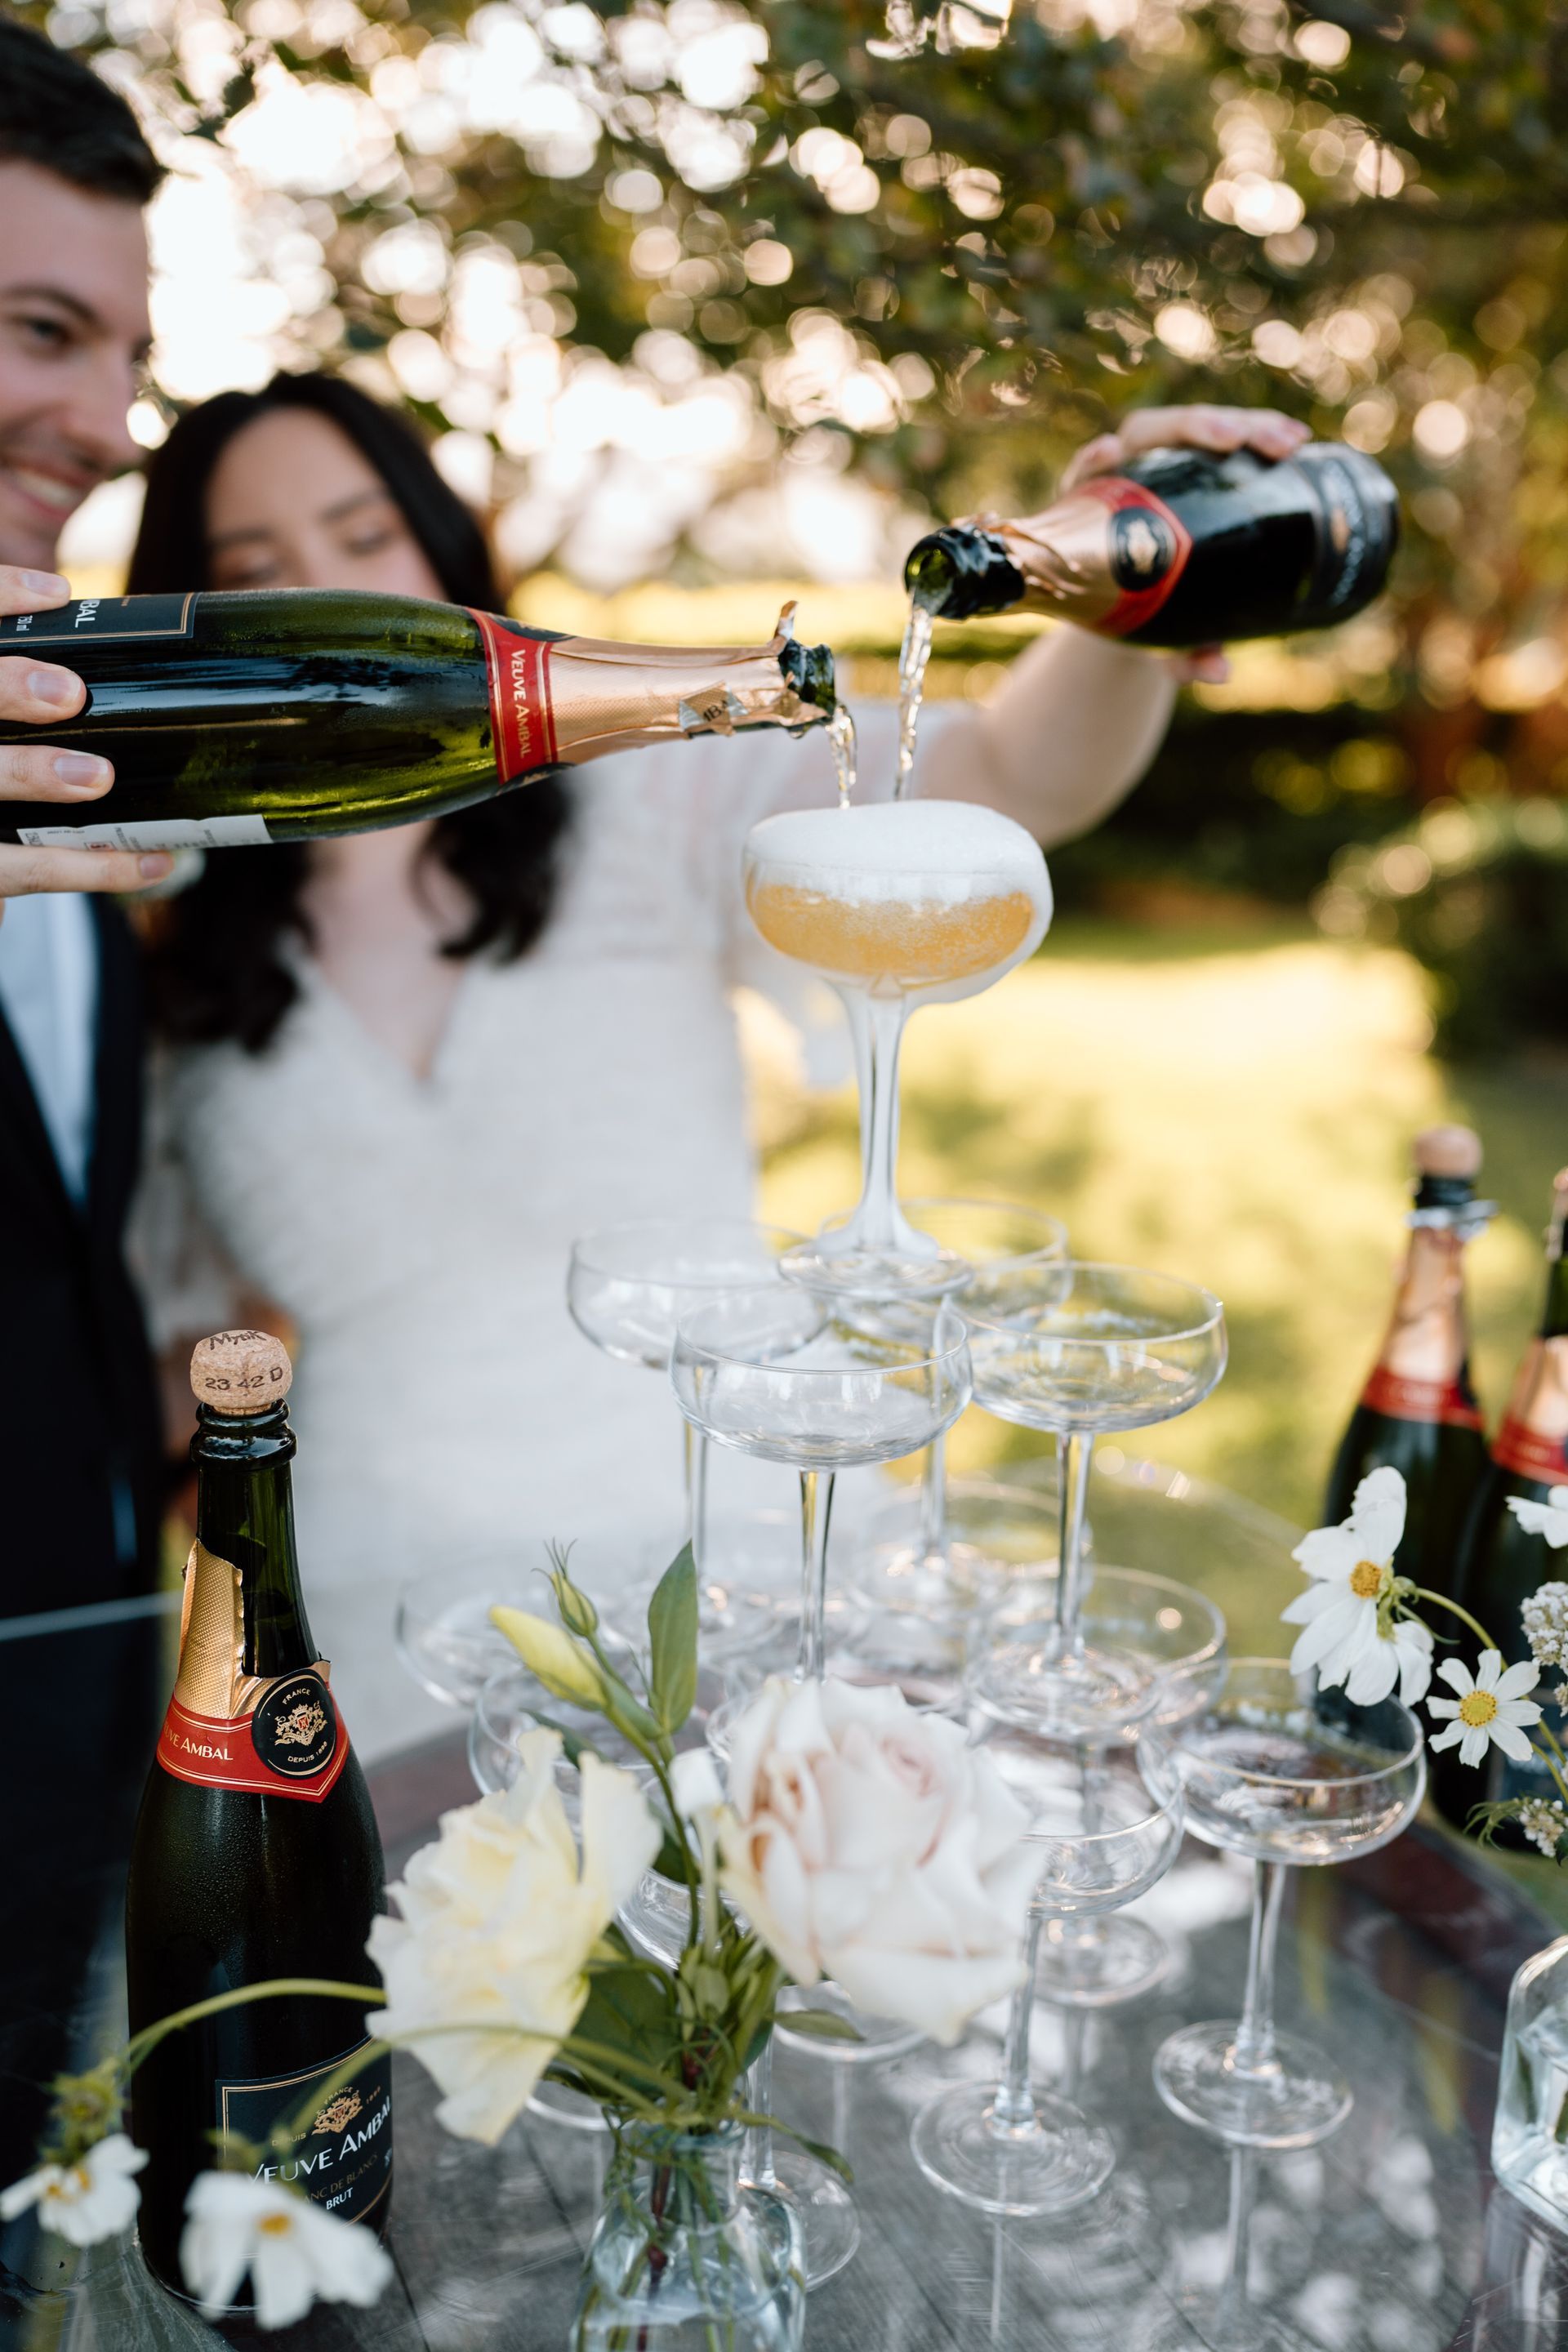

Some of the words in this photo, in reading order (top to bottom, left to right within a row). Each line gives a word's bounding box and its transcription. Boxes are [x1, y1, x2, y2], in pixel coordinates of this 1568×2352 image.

[510, 649, 527, 701] VEUVE
[514, 704, 532, 759] AMBAL
[205, 1377, 230, 1390] 23
[237, 1375, 265, 1389] 42
[269, 1366, 283, 1382] D
[283, 1688, 311, 1705] FRANCE
[180, 1737, 234, 1761] AMBAL
[287, 1753, 315, 1763] DEPUIS
[271, 2132, 306, 2147] DUIS
[330, 2177, 345, 2194] DE
[326, 2186, 354, 2211] BRUT
